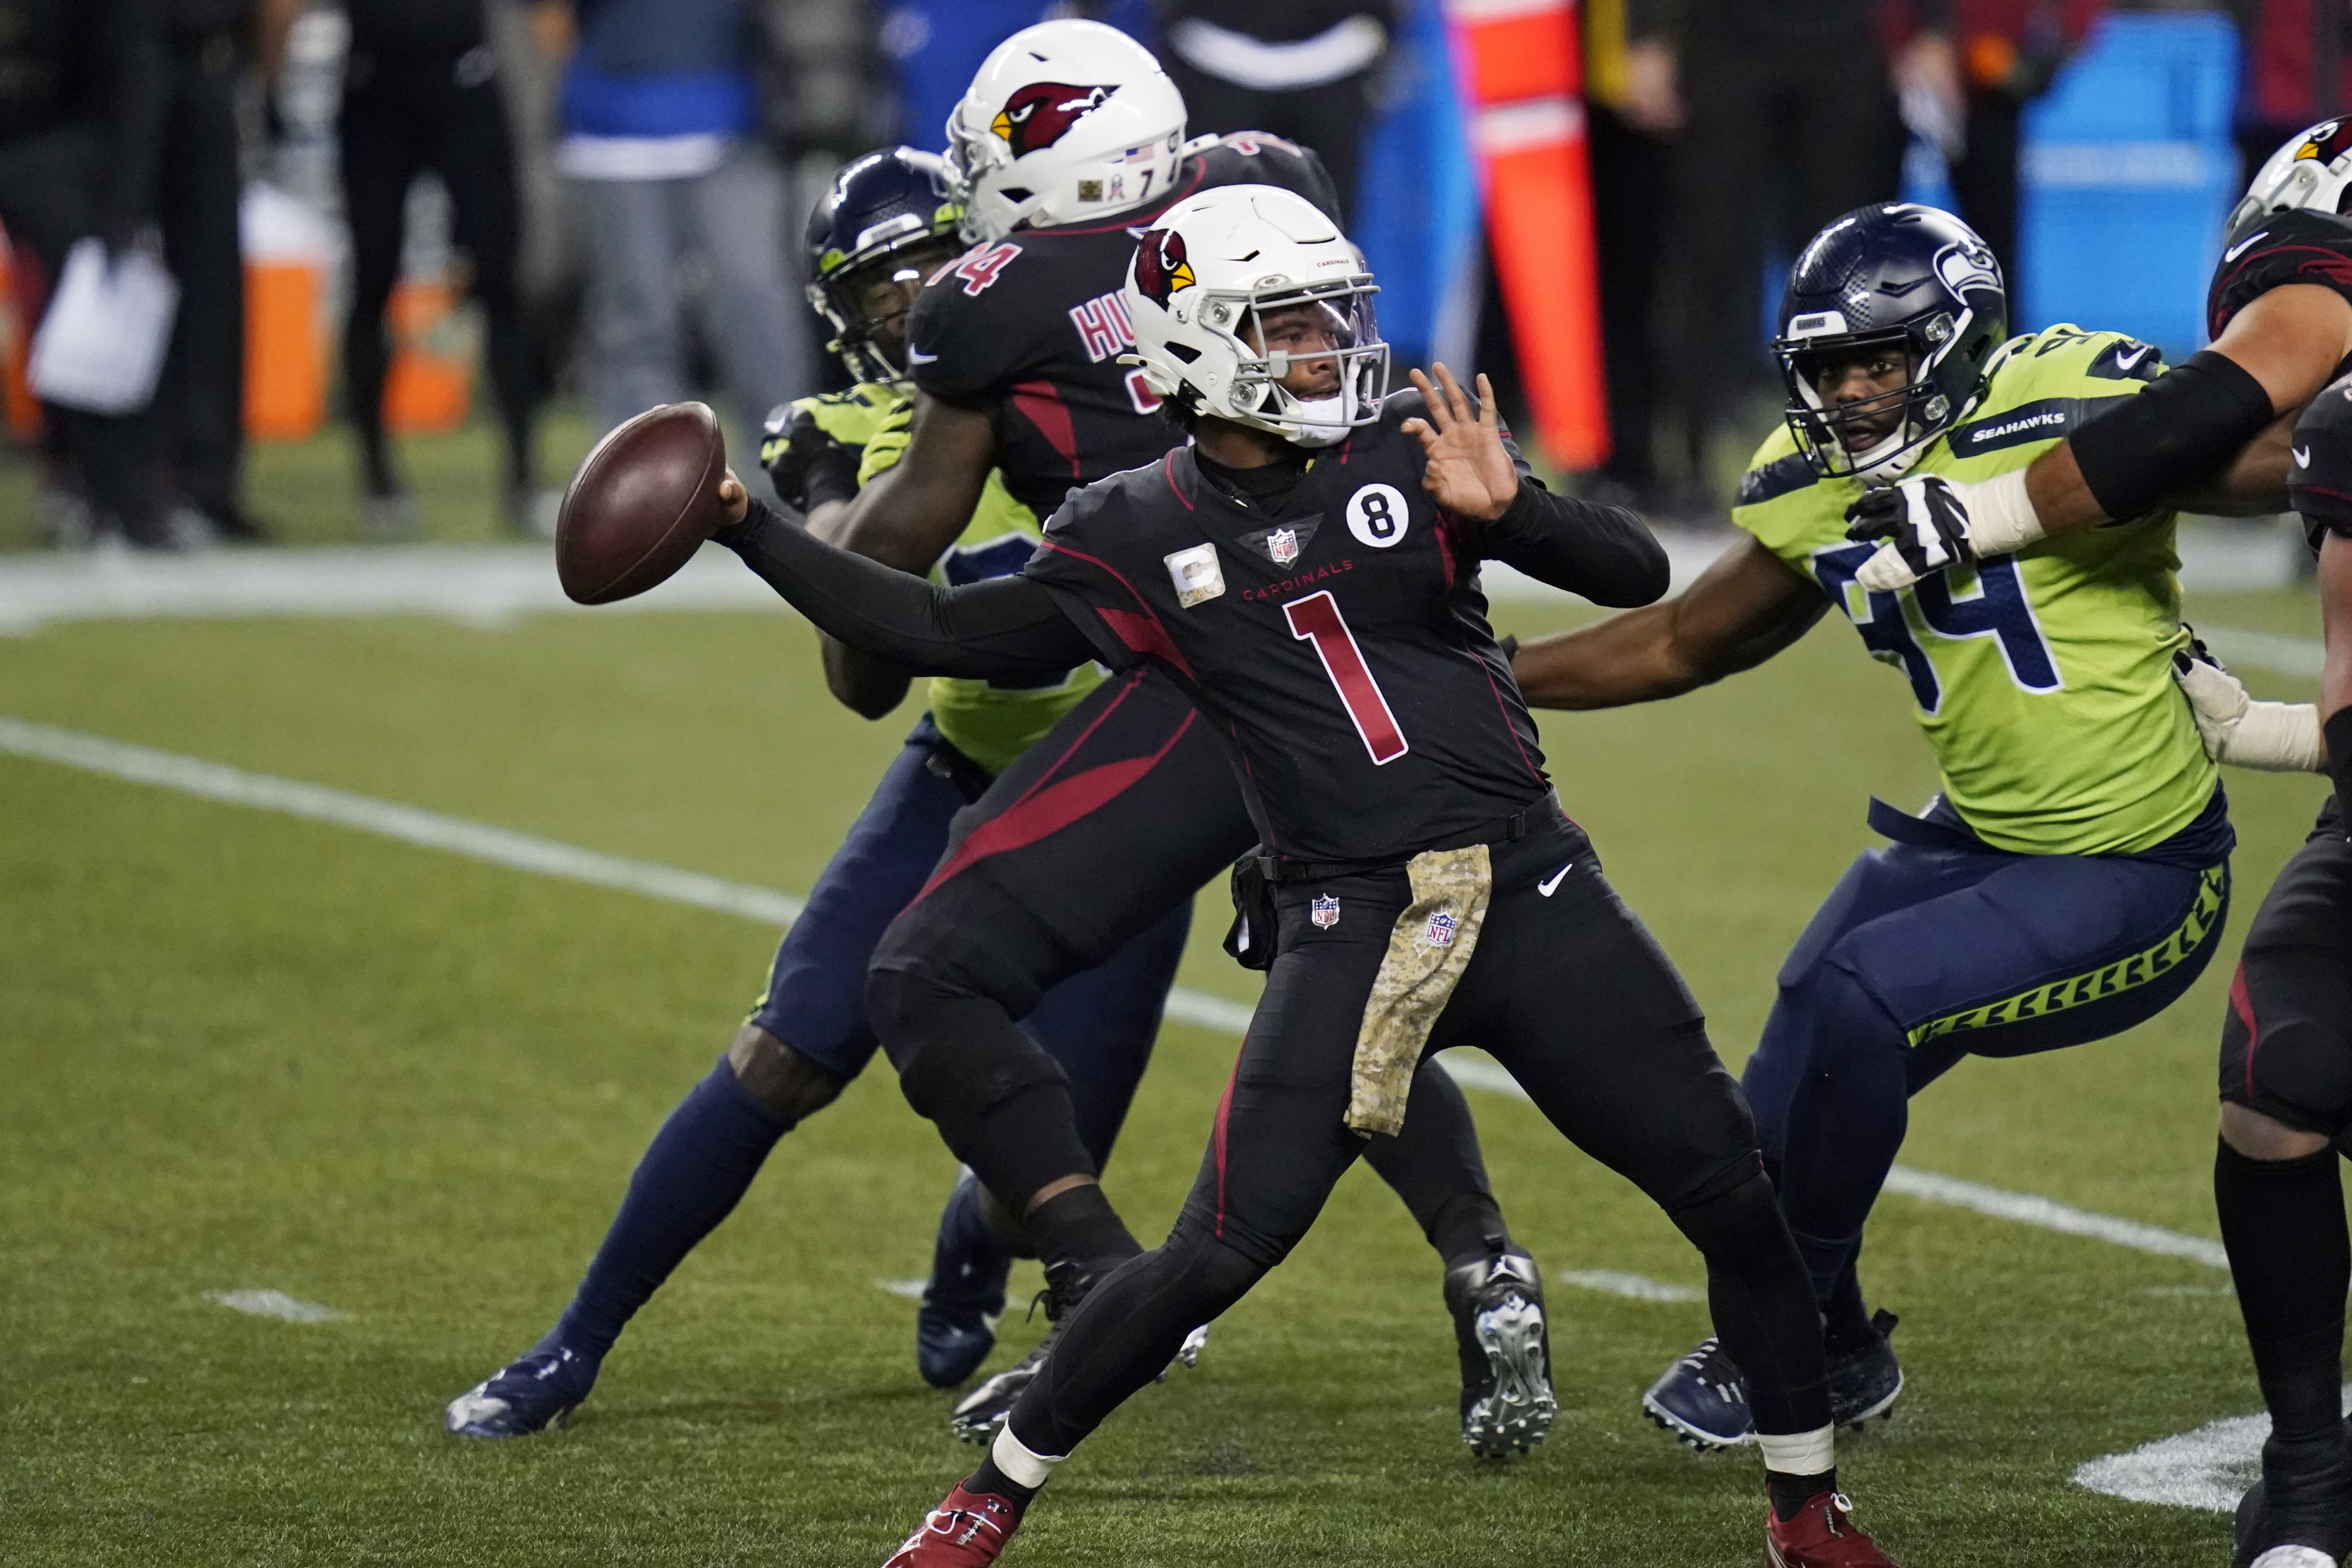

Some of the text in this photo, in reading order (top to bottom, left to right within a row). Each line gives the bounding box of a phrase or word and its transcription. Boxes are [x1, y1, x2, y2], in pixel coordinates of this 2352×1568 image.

[1317, 259, 1349, 267] CARDINALS
[1972, 413, 2065, 443] SEAHAWKS
[1360, 492, 1395, 539] 8
[1275, 543, 1295, 557] NFL
[1242, 559, 1354, 601] CARDINALS
[1810, 539, 2066, 718] 94
[1282, 590, 1409, 766] 1
[1316, 911, 1335, 922] NFL
[1428, 925, 1450, 942] NFL
